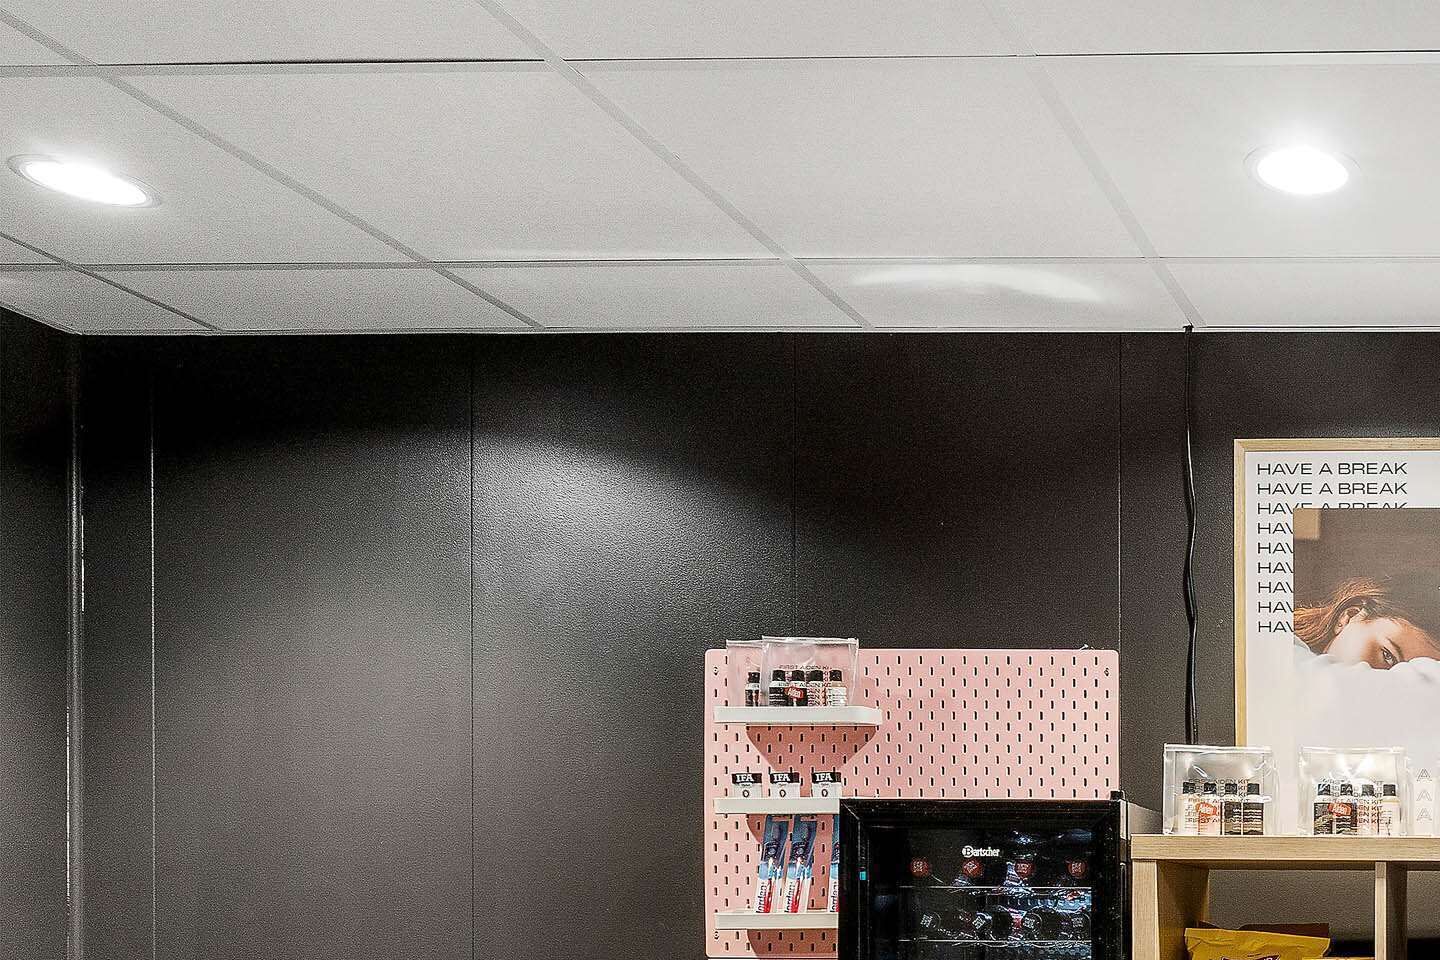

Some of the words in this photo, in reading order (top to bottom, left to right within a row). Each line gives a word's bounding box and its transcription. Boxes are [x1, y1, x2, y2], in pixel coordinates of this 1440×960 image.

[1257, 463, 1313, 475] HAVE
[1319, 463, 1333, 475] A
[1338, 463, 1408, 475] BREAK
[1257, 482, 1313, 495] HAVE
[1319, 482, 1333, 495] A
[1338, 482, 1408, 495] BREAK
[1257, 522, 1294, 535] HAV
[1257, 542, 1294, 554] HAV
[1257, 561, 1294, 574] HAV
[1257, 581, 1294, 594] HAV
[1257, 601, 1294, 613] HAV
[1257, 621, 1294, 633] HAV
[735, 773, 755, 782] IFA
[773, 773, 791, 782] IFA
[815, 772, 834, 781] IFA
[961, 845, 1000, 858] Bartscher
